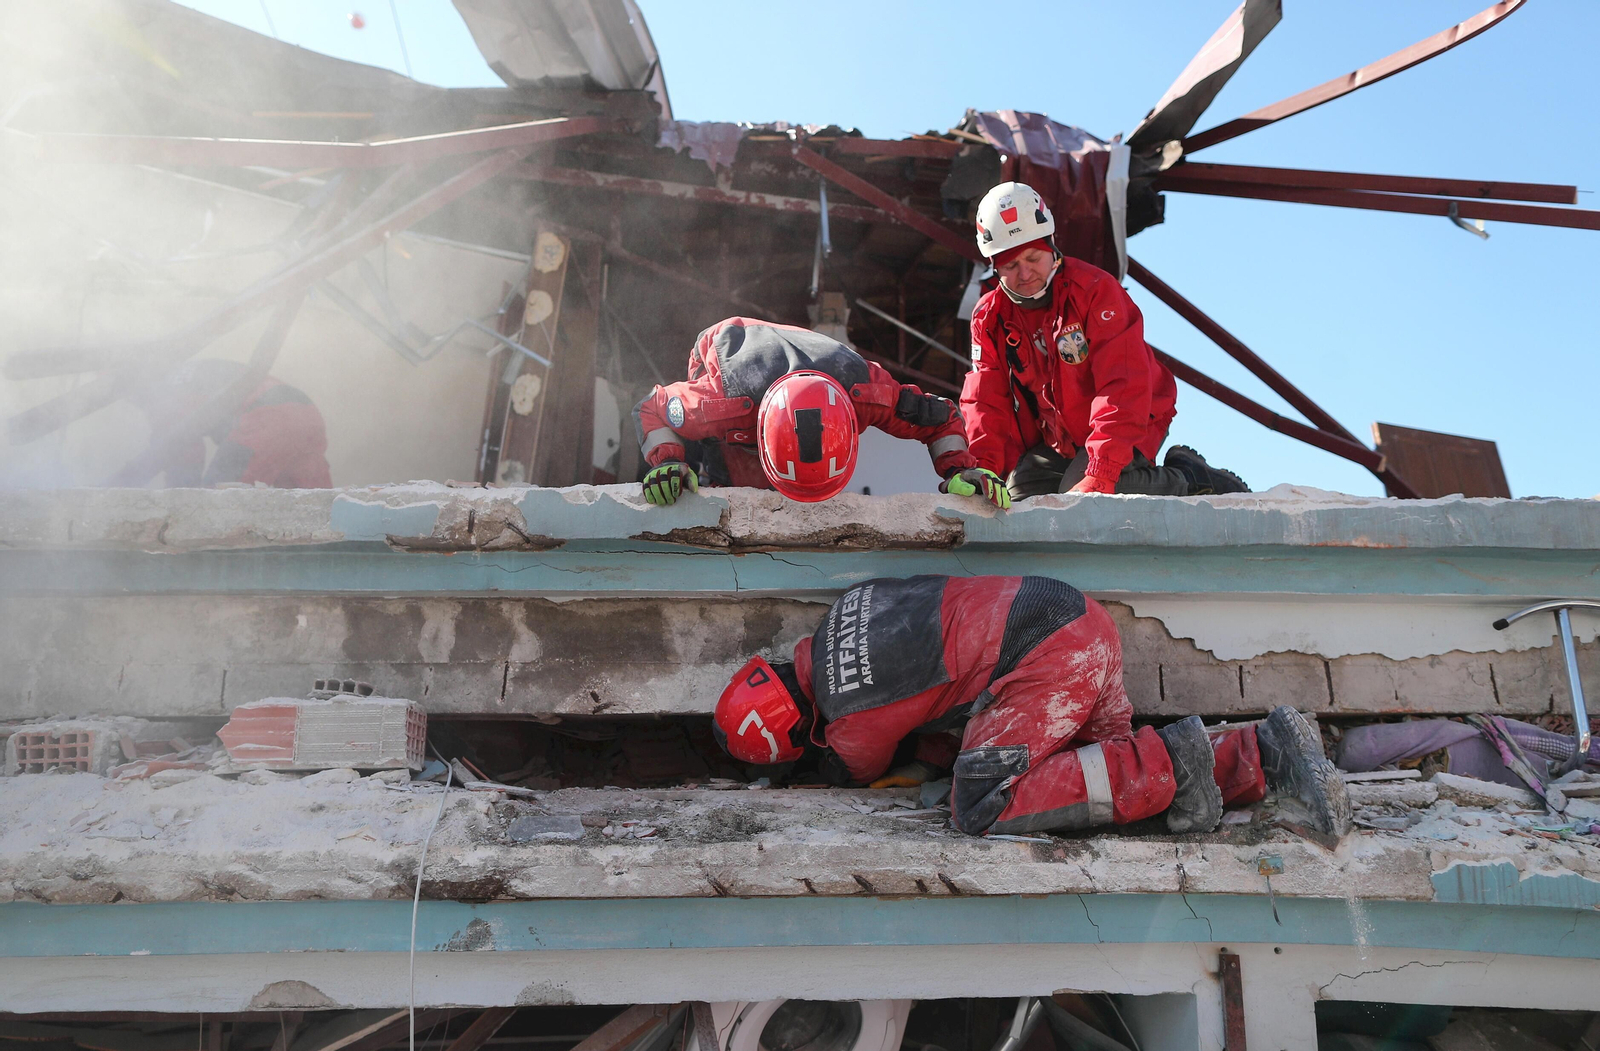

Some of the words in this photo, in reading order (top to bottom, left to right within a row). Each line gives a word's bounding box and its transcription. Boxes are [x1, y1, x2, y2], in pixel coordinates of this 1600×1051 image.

[1060, 324, 1080, 335] KUT
[859, 584, 875, 634] KURTARMA
[837, 586, 862, 694] İTFAİYESİ
[859, 635, 874, 685] ARAMA
[826, 652, 837, 695] MUĞLA
